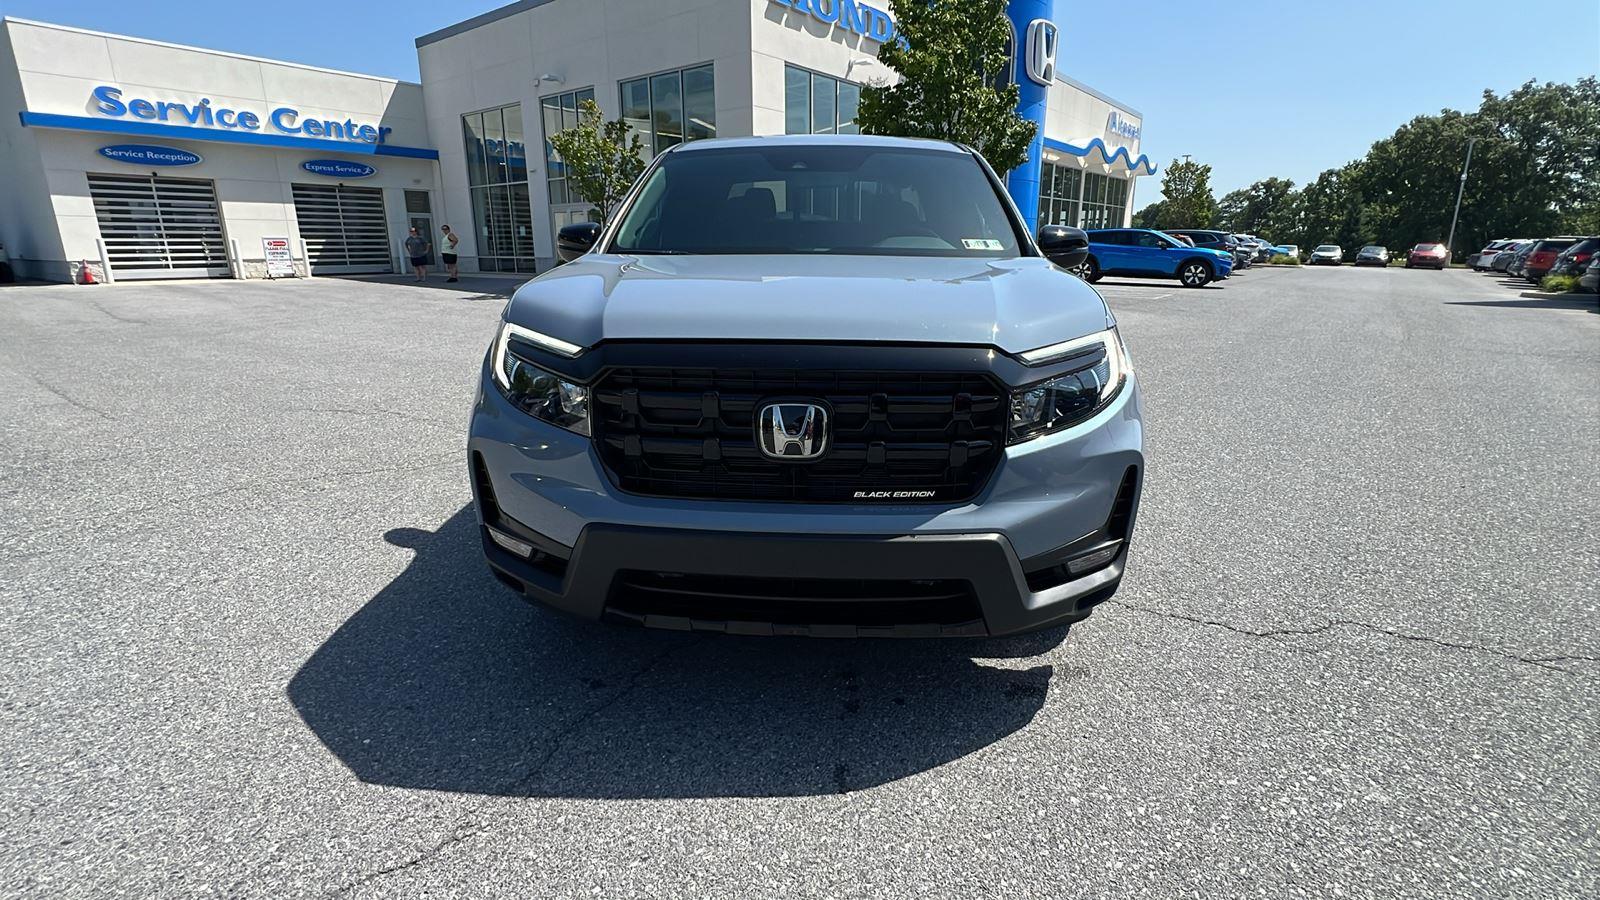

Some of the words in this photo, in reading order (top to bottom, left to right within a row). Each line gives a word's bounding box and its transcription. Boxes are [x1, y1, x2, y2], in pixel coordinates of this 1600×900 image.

[773, 0, 910, 51] OND
[92, 85, 261, 131] Service
[270, 107, 393, 145] Center
[104, 147, 145, 159] Service
[146, 151, 197, 163] Reception
[305, 162, 334, 172] Express
[335, 164, 362, 173] Service
[853, 490, 892, 498] BLACK
[892, 490, 936, 498] EDITION
